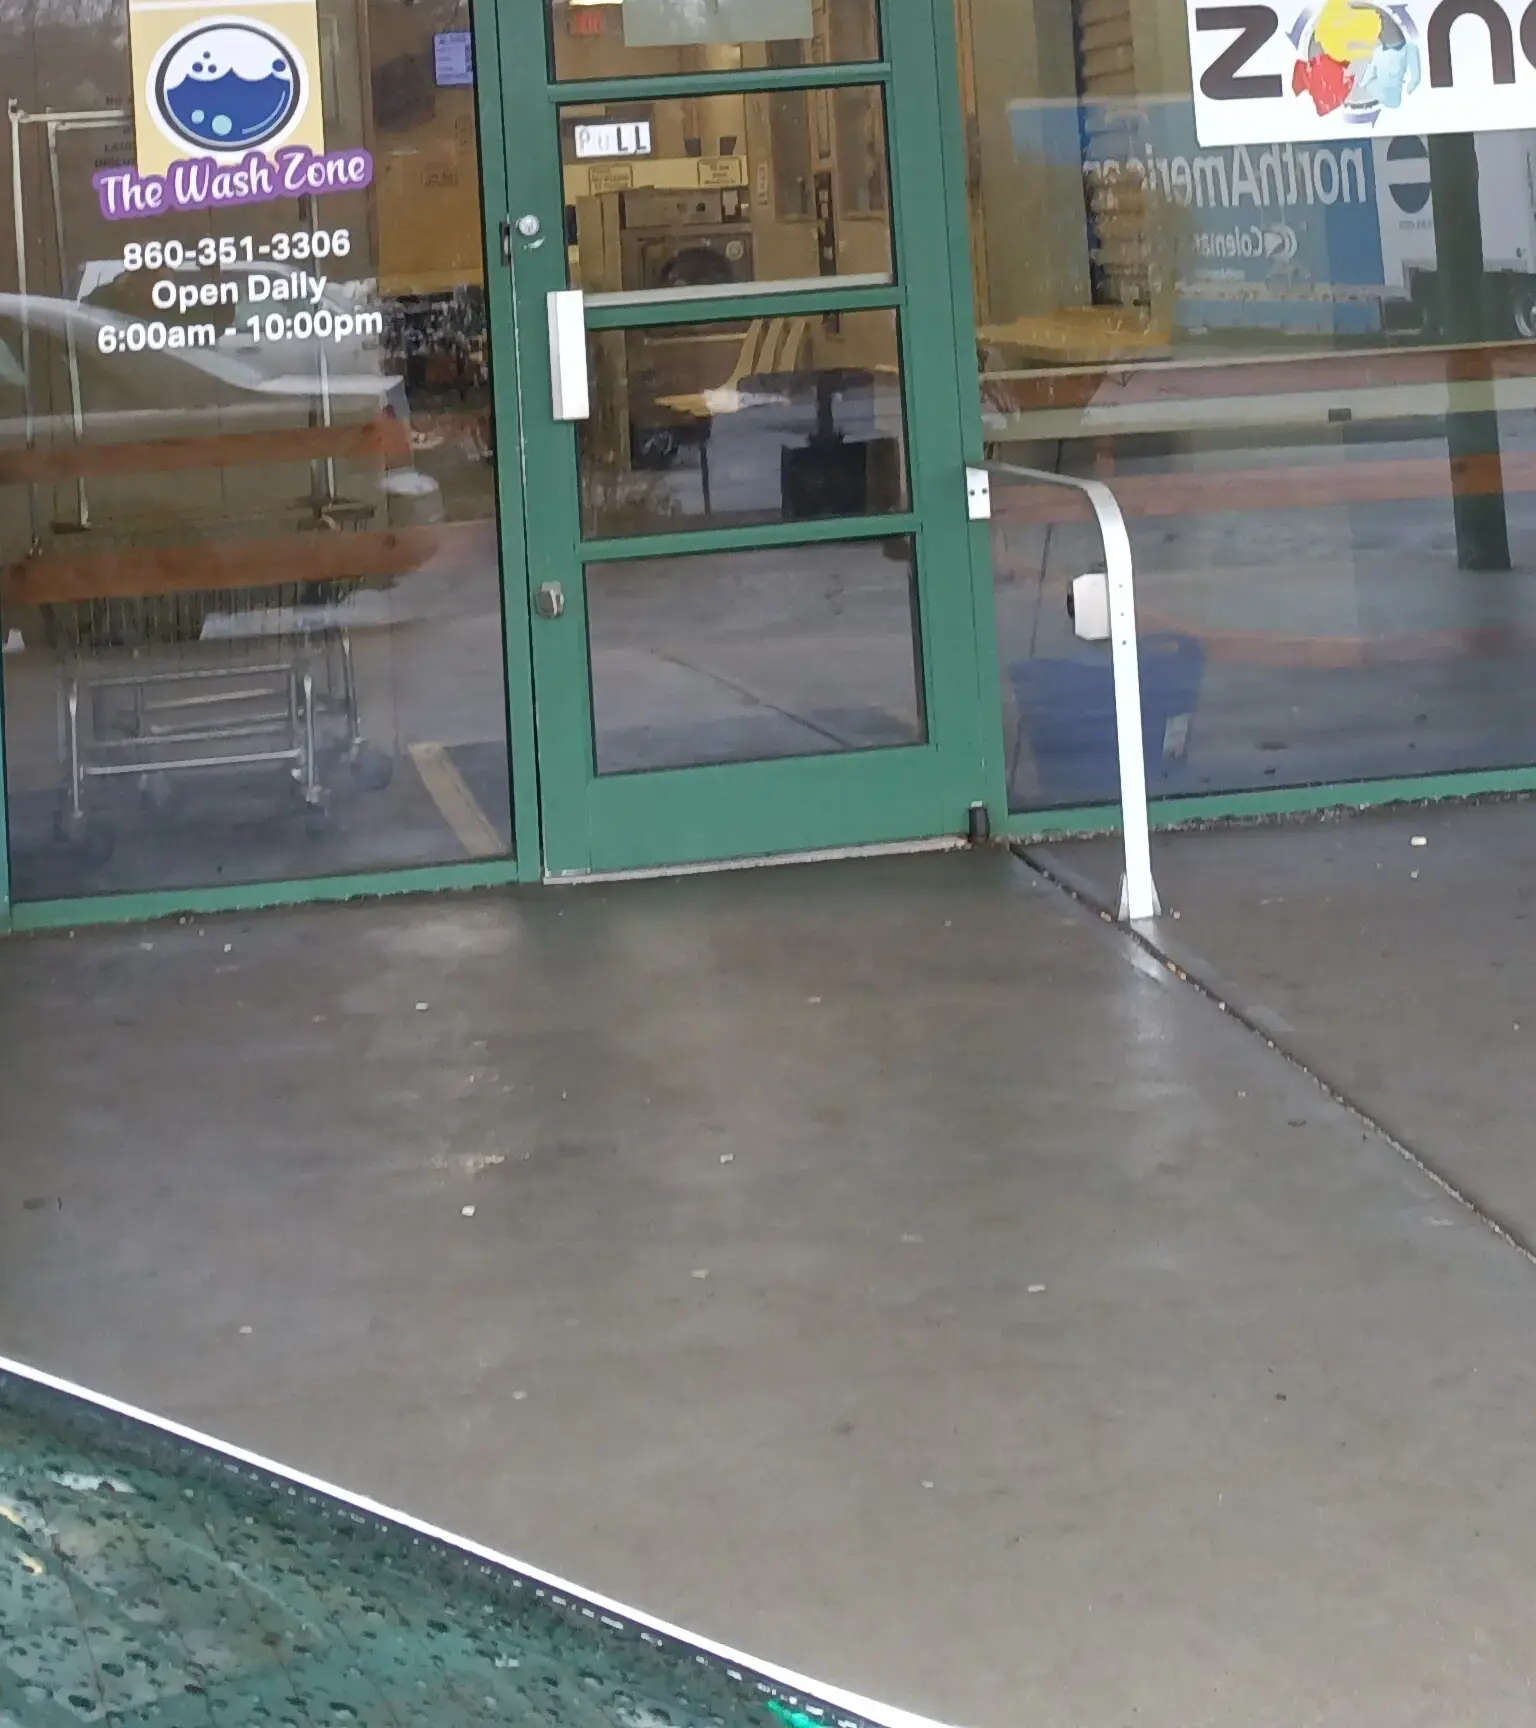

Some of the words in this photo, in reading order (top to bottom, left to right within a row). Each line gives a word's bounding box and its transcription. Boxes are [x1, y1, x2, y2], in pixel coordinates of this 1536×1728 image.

[579, 124, 647, 152] PULL
[100, 173, 163, 214] The
[174, 156, 274, 205] Wash
[281, 152, 365, 190] Zone
[123, 229, 350, 272] 860-351-3306
[152, 280, 239, 314] Open
[247, 272, 328, 304] Daily
[98, 322, 215, 354] 6:00am
[247, 309, 383, 343] 10:00pm
